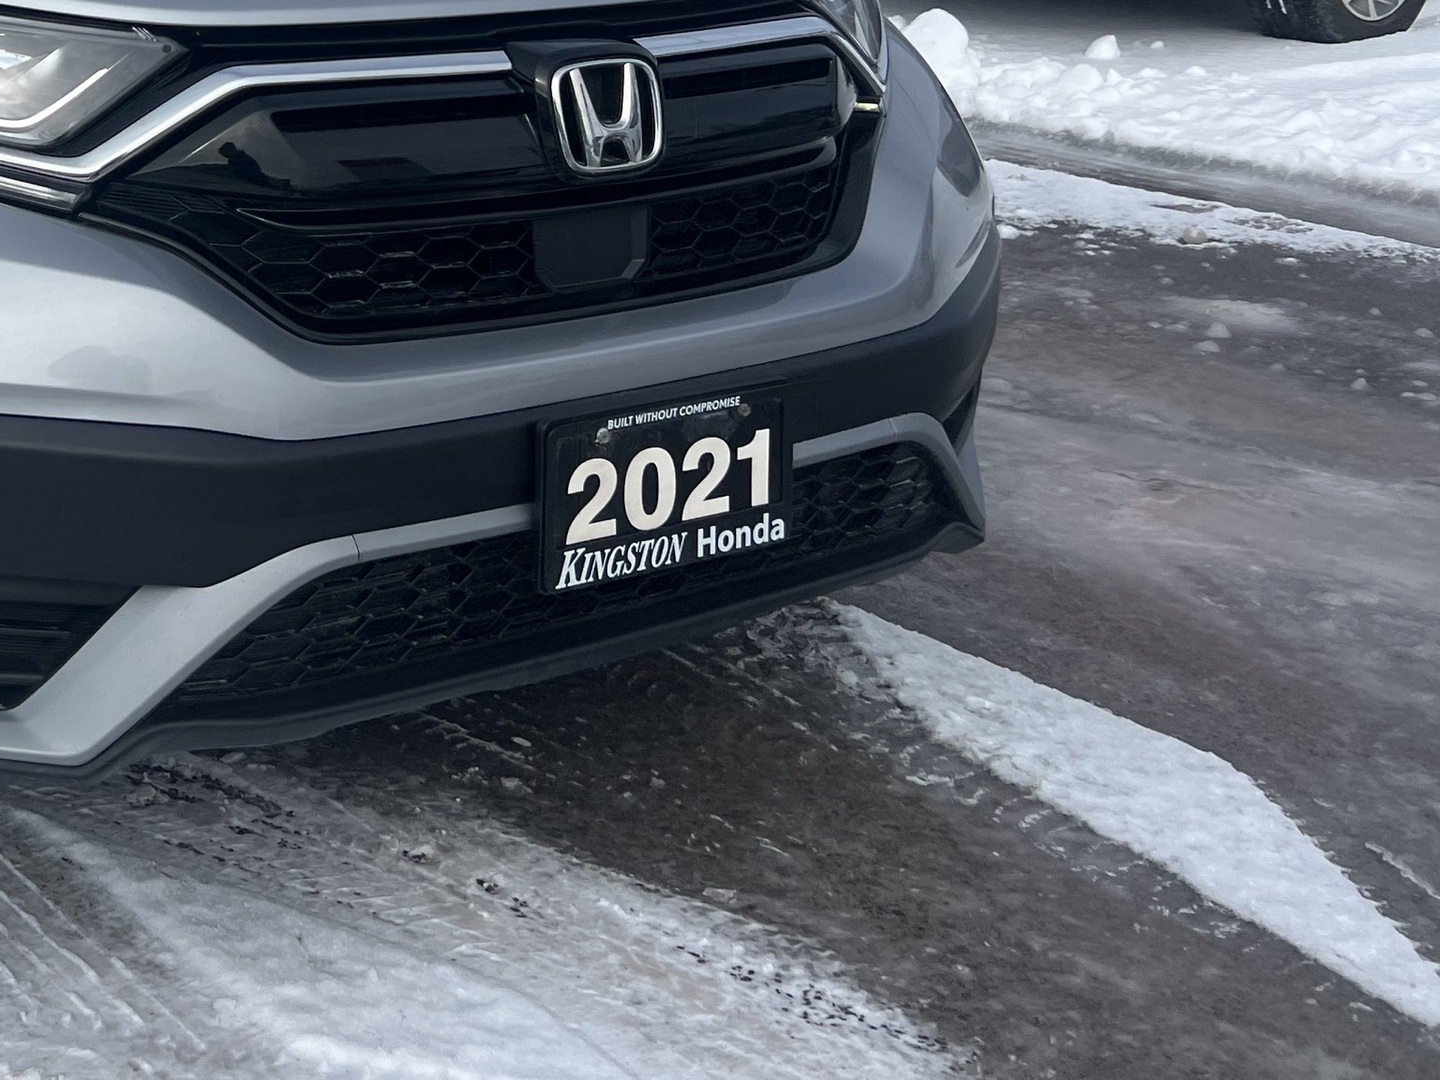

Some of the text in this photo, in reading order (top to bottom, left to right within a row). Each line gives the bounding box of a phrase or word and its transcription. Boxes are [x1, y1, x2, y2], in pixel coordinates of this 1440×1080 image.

[607, 395, 741, 430] BUILT WITHOUT COMPROMISE
[565, 428, 770, 546] 2021
[555, 512, 785, 590] KINGSTON Honda
